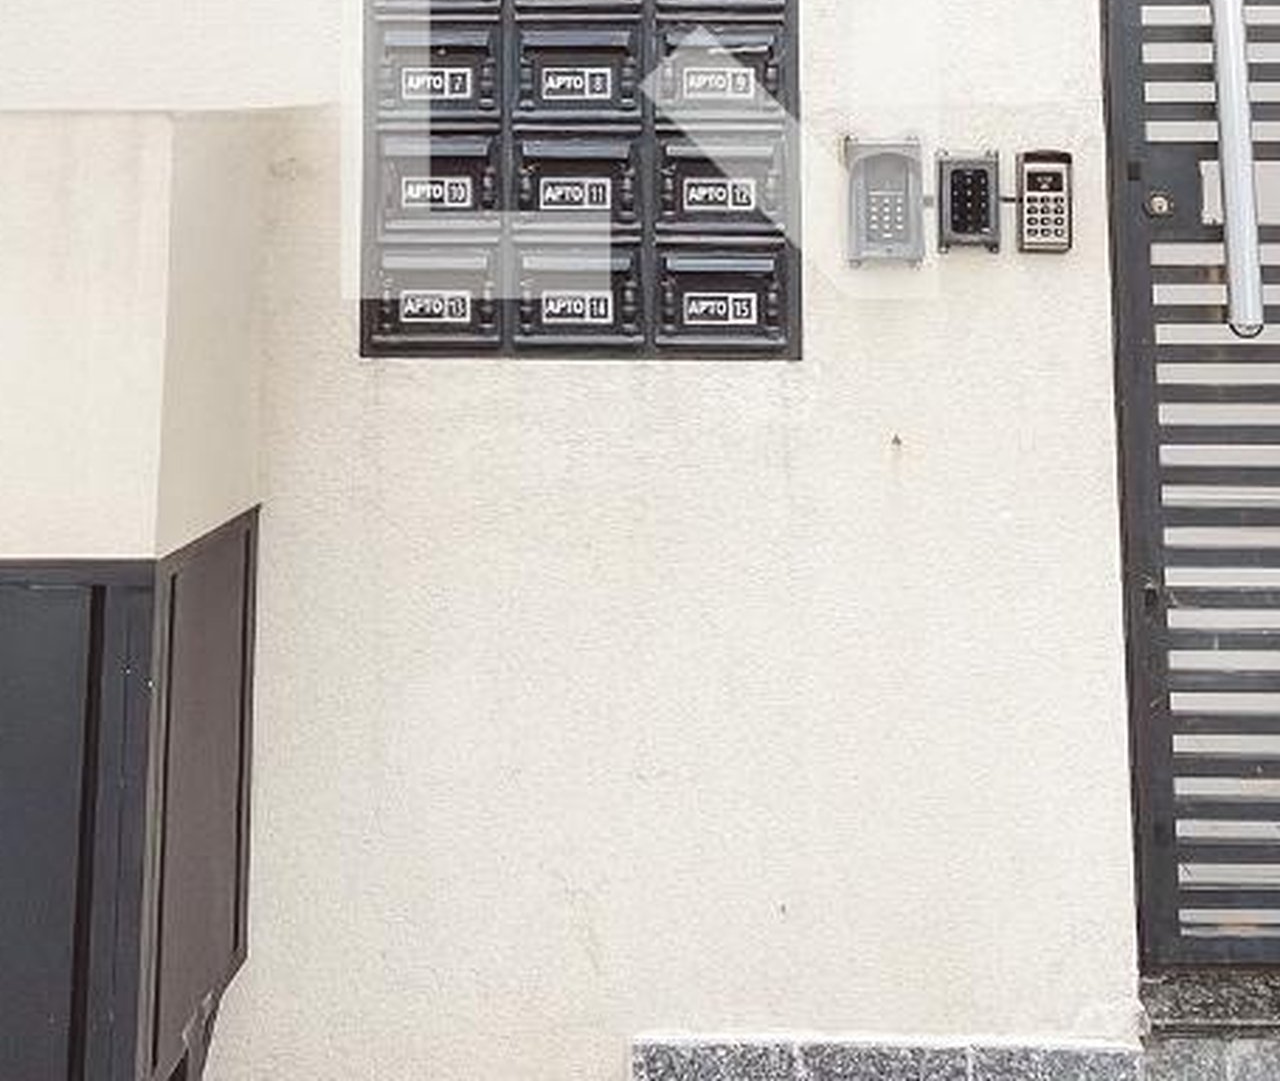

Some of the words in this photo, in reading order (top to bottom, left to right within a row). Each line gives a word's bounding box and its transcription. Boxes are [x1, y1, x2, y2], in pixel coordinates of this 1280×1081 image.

[407, 75, 444, 89] APTO
[546, 75, 584, 89] APTO
[689, 75, 727, 90] APTO
[407, 185, 444, 199] APTO
[451, 184, 466, 200] 10
[544, 186, 584, 201] APTO
[591, 185, 603, 201] 11
[689, 186, 727, 201] APTO
[733, 187, 749, 203] 12
[405, 299, 442, 313] APTO
[545, 299, 582, 314] APTO
[687, 301, 727, 315] APTO
[733, 301, 749, 316] 15
